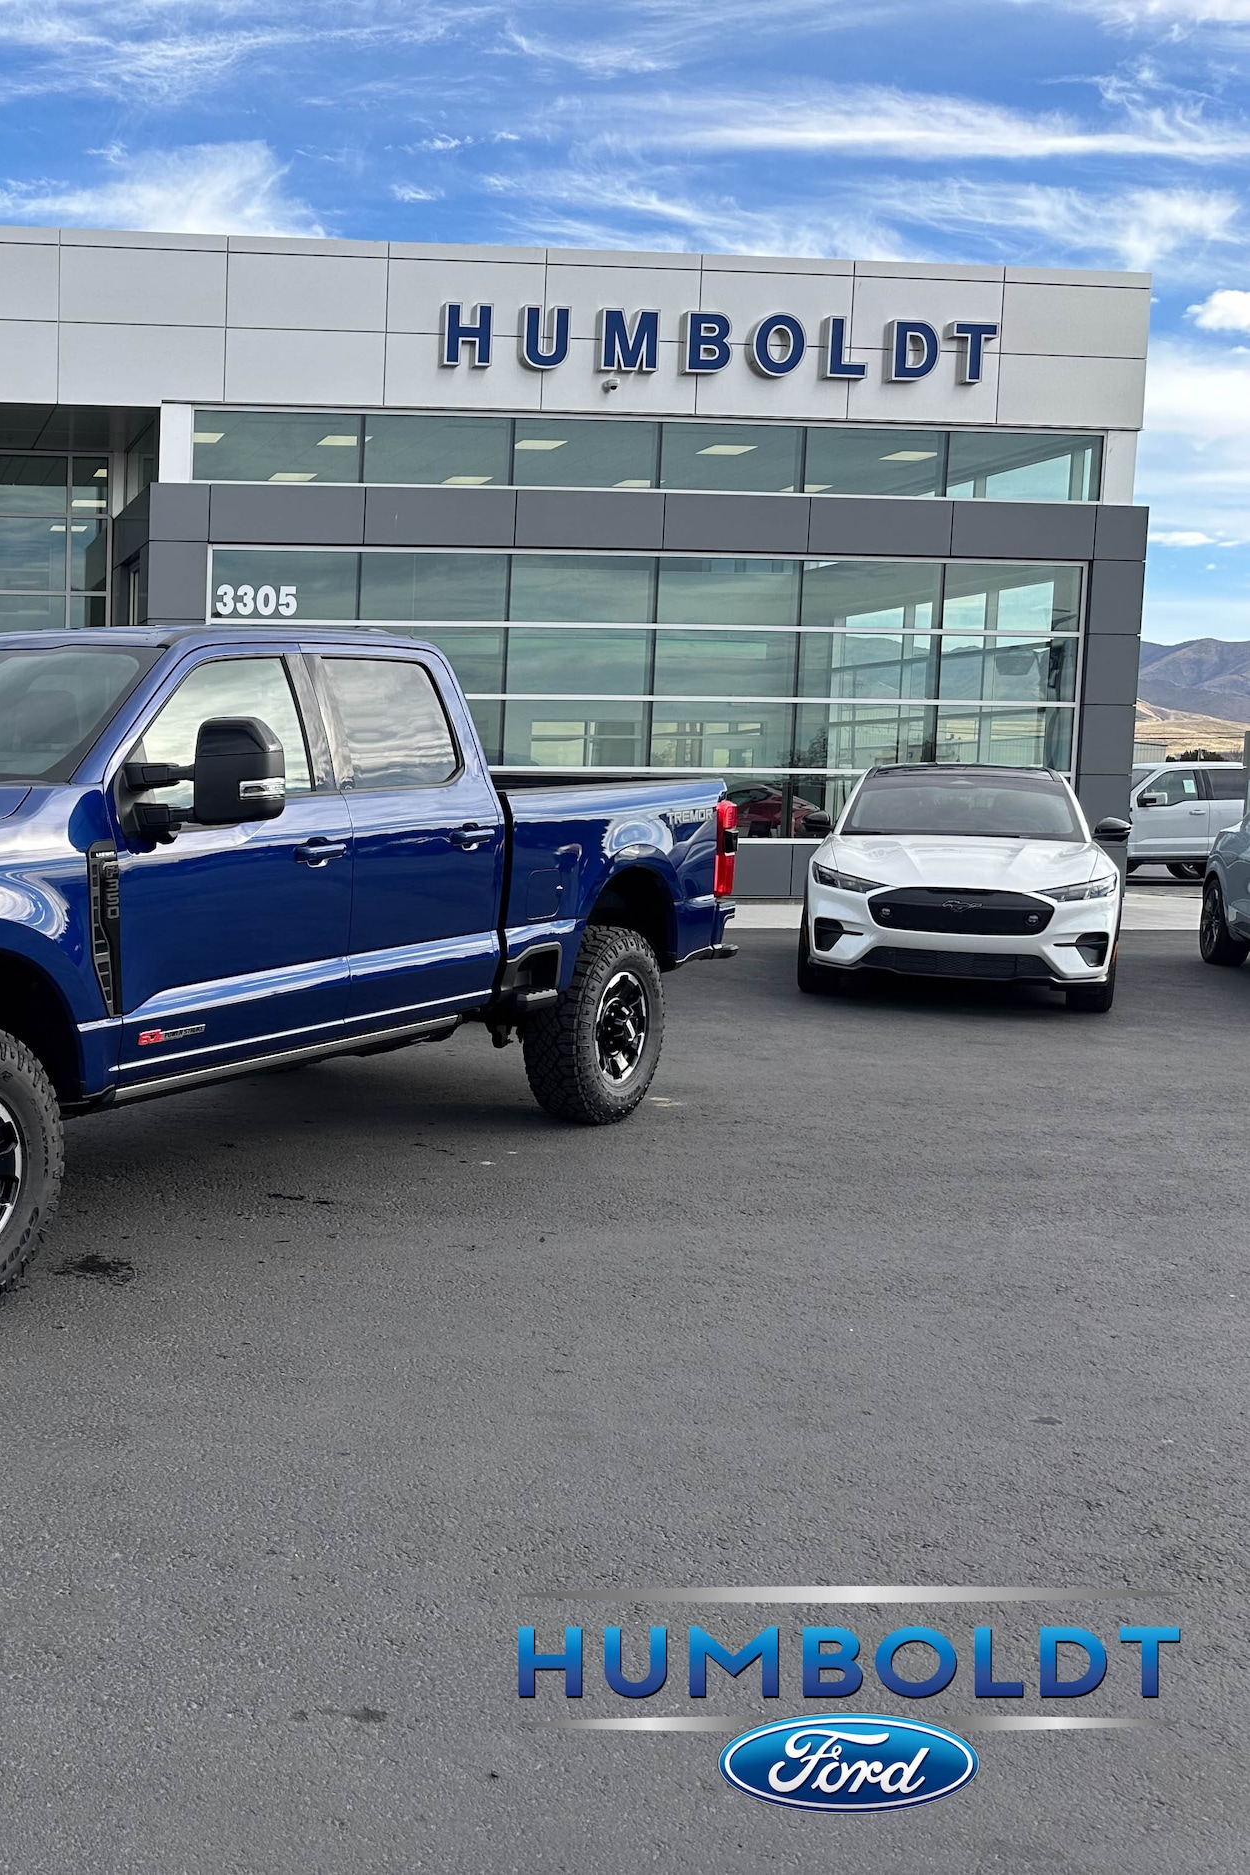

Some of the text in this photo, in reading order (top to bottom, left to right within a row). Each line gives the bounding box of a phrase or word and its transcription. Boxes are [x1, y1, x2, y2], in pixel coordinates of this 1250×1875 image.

[439, 301, 1000, 384] HUMBOLDT
[215, 584, 297, 616] 3305
[666, 808, 713, 825] TREMOR
